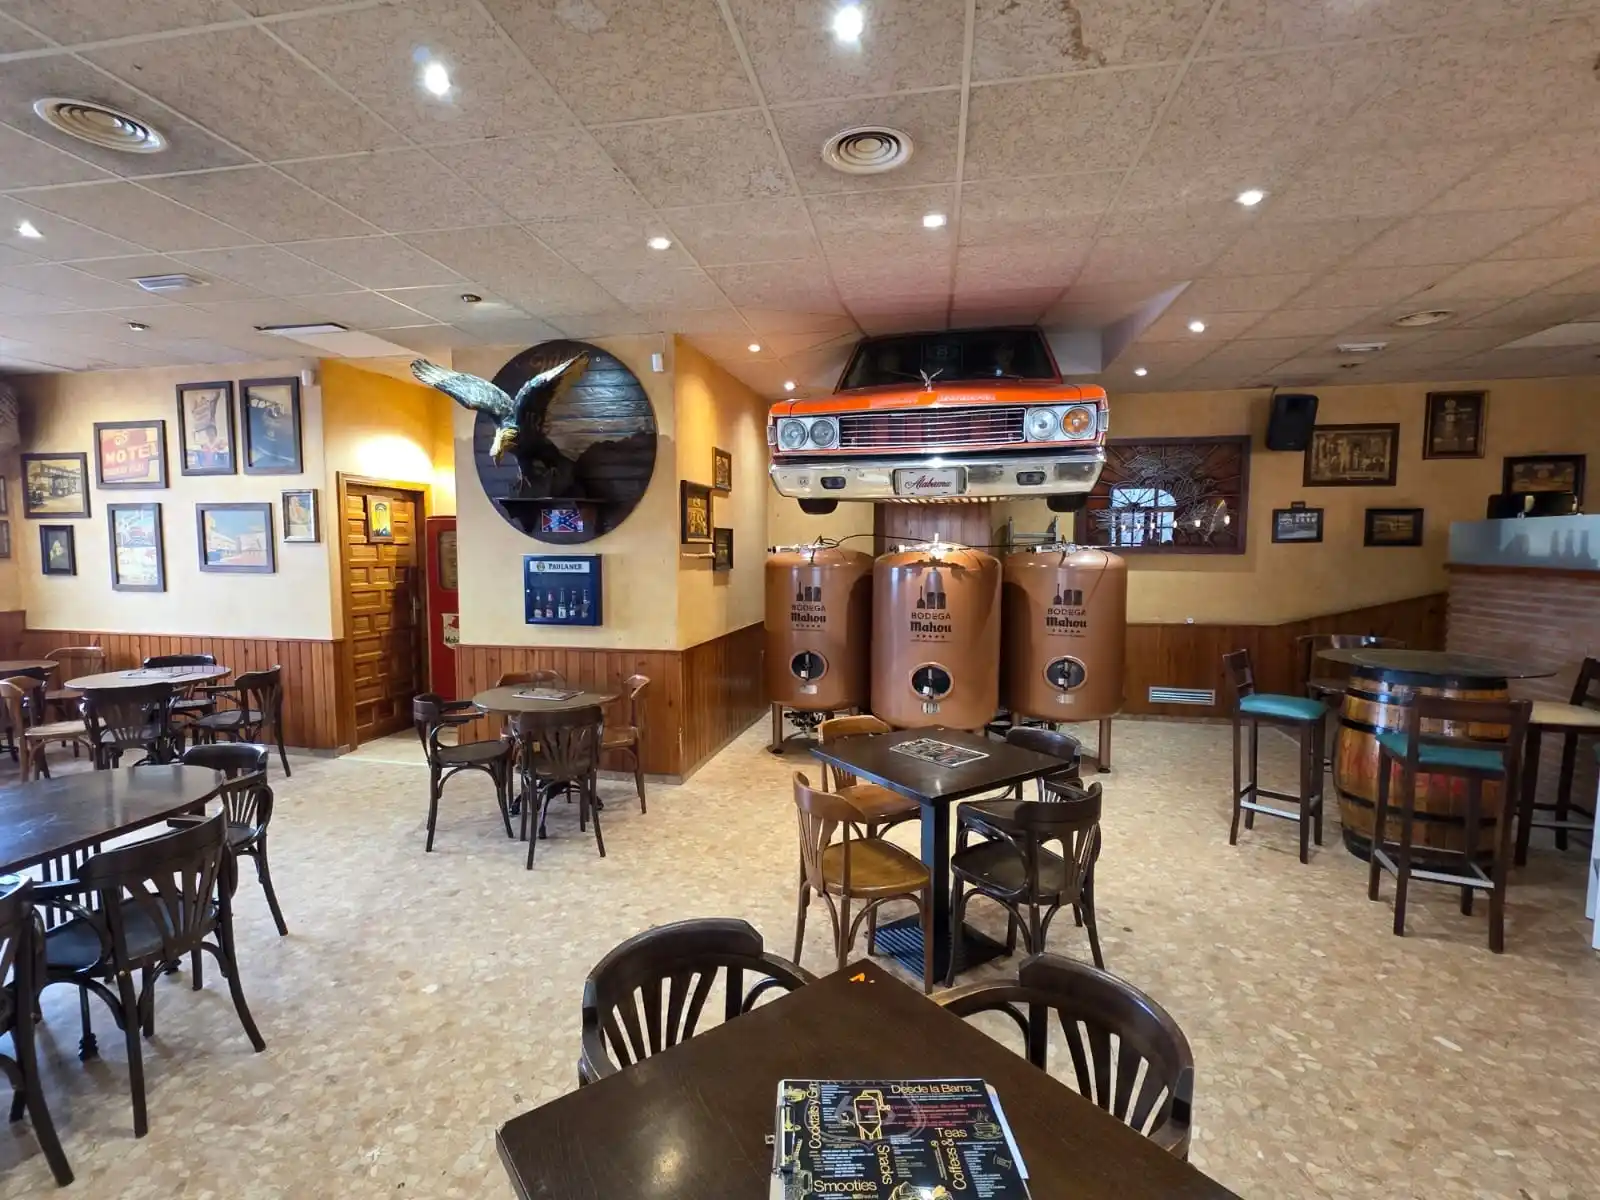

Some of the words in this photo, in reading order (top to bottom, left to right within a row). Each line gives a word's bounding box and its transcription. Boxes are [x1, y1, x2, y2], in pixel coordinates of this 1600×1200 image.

[905, 475, 952, 489] Alabama
[791, 604, 826, 612] BODEGA
[1047, 607, 1086, 617] BODEGA
[791, 612, 826, 623] Mahou
[911, 612, 951, 620] BODEGA
[910, 620, 952, 633] Mahou
[1046, 616, 1087, 628] Mahou
[891, 1084, 928, 1094] Desde
[930, 1084, 940, 1093] la
[934, 1127, 968, 1138] Teas
[876, 1144, 893, 1185] Snacks
[947, 1147, 967, 1190] Coffees
[813, 1179, 878, 1192] Smooties
